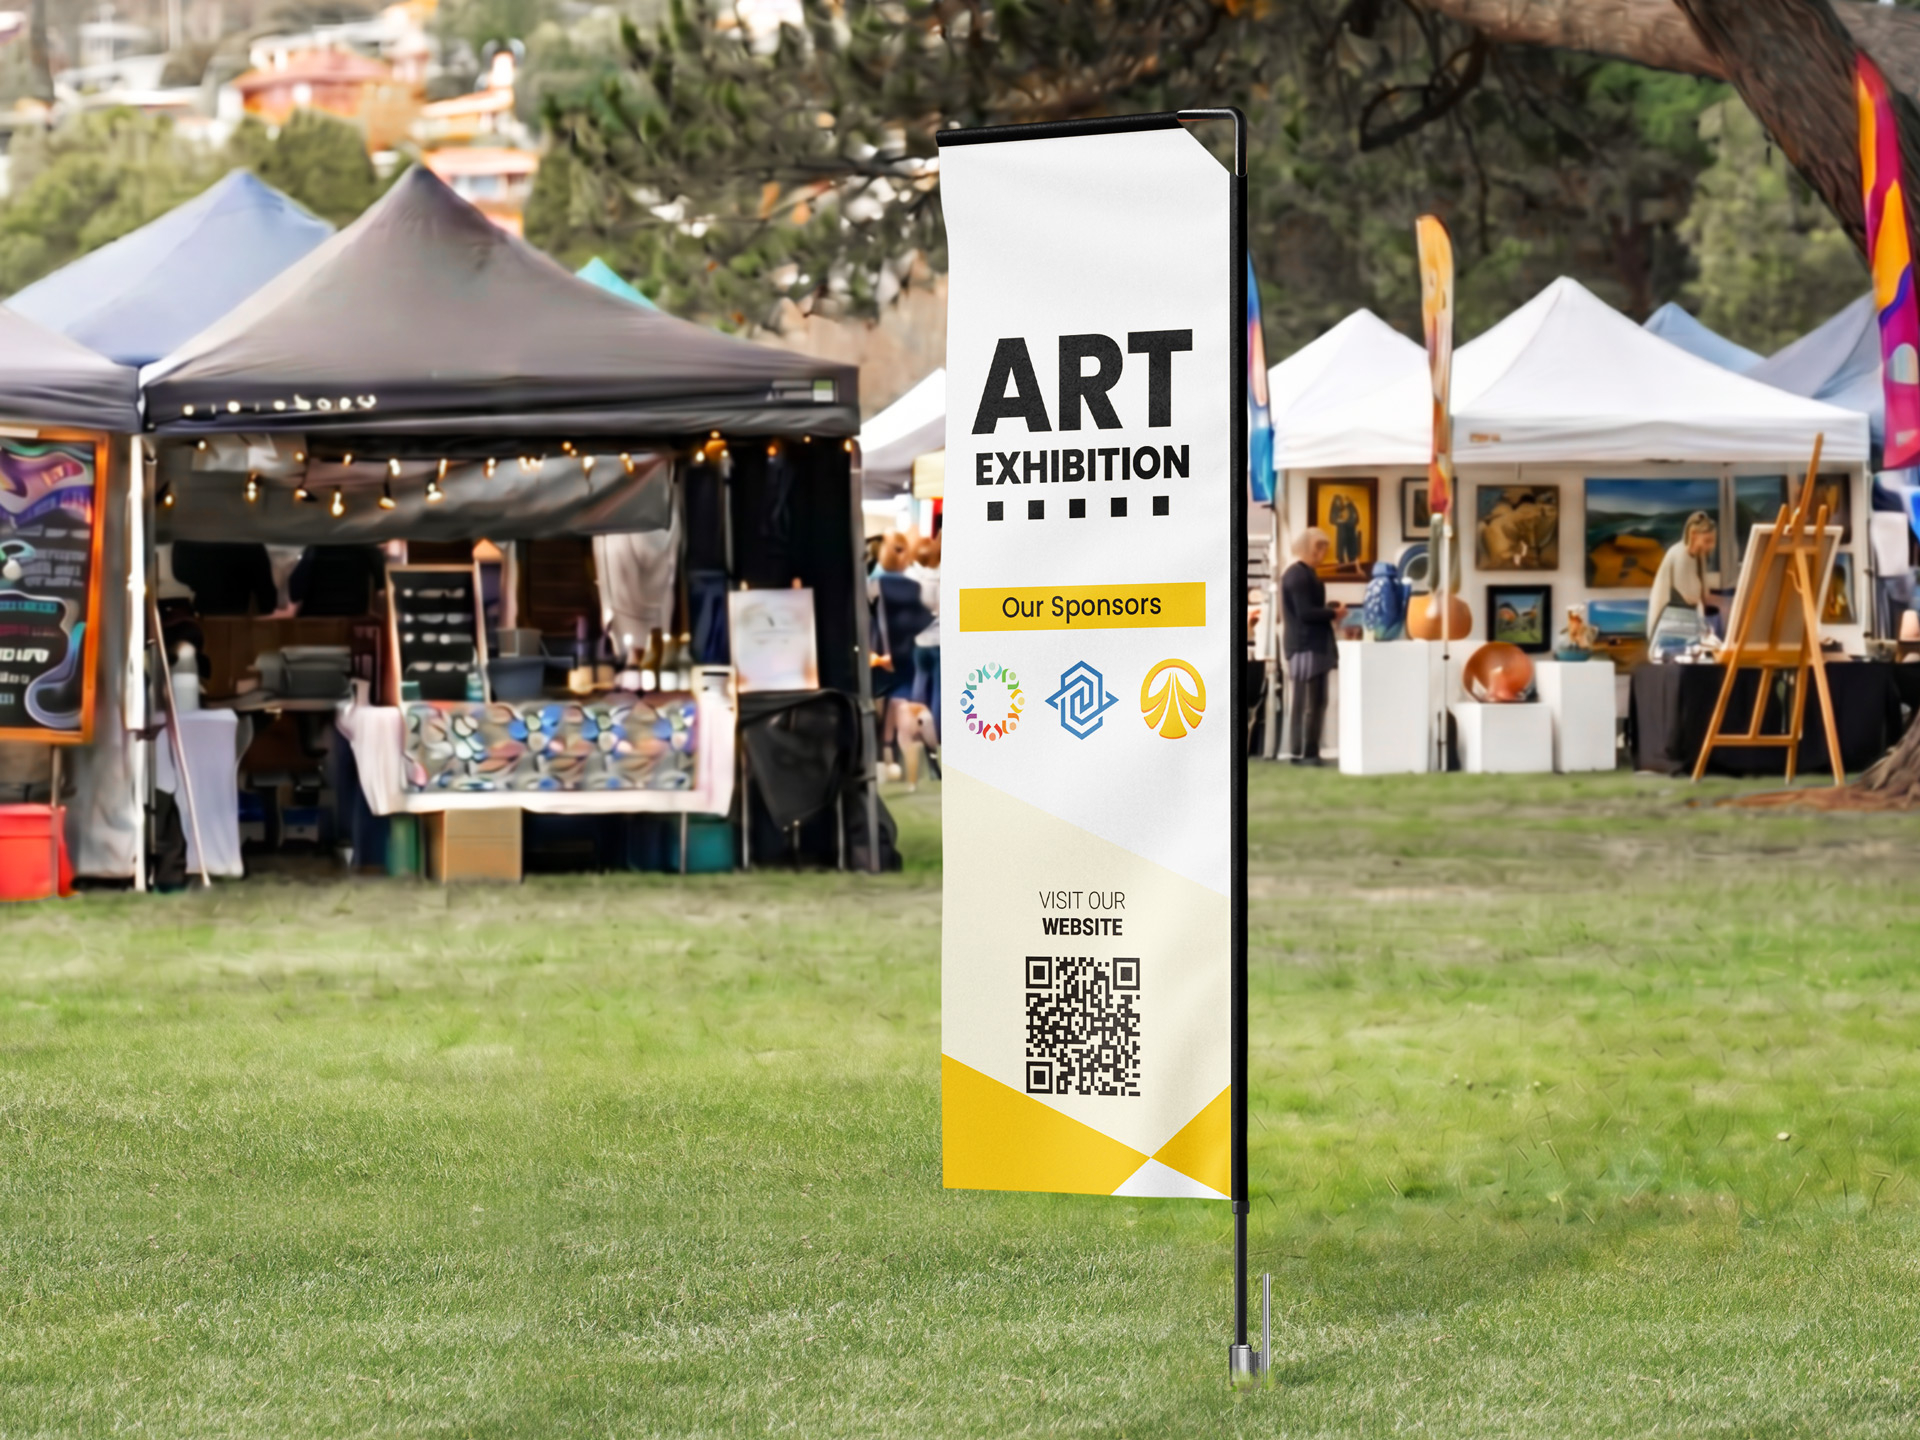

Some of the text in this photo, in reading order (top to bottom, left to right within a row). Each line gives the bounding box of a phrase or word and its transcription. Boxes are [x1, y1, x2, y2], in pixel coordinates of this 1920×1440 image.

[972, 329, 1192, 434] ART
[976, 445, 1189, 485] EXHIBITION
[1003, 596, 1161, 624] Our Sponsors
[1039, 891, 1125, 909] VISIT OUR
[1042, 918, 1122, 936] WEBSITE
